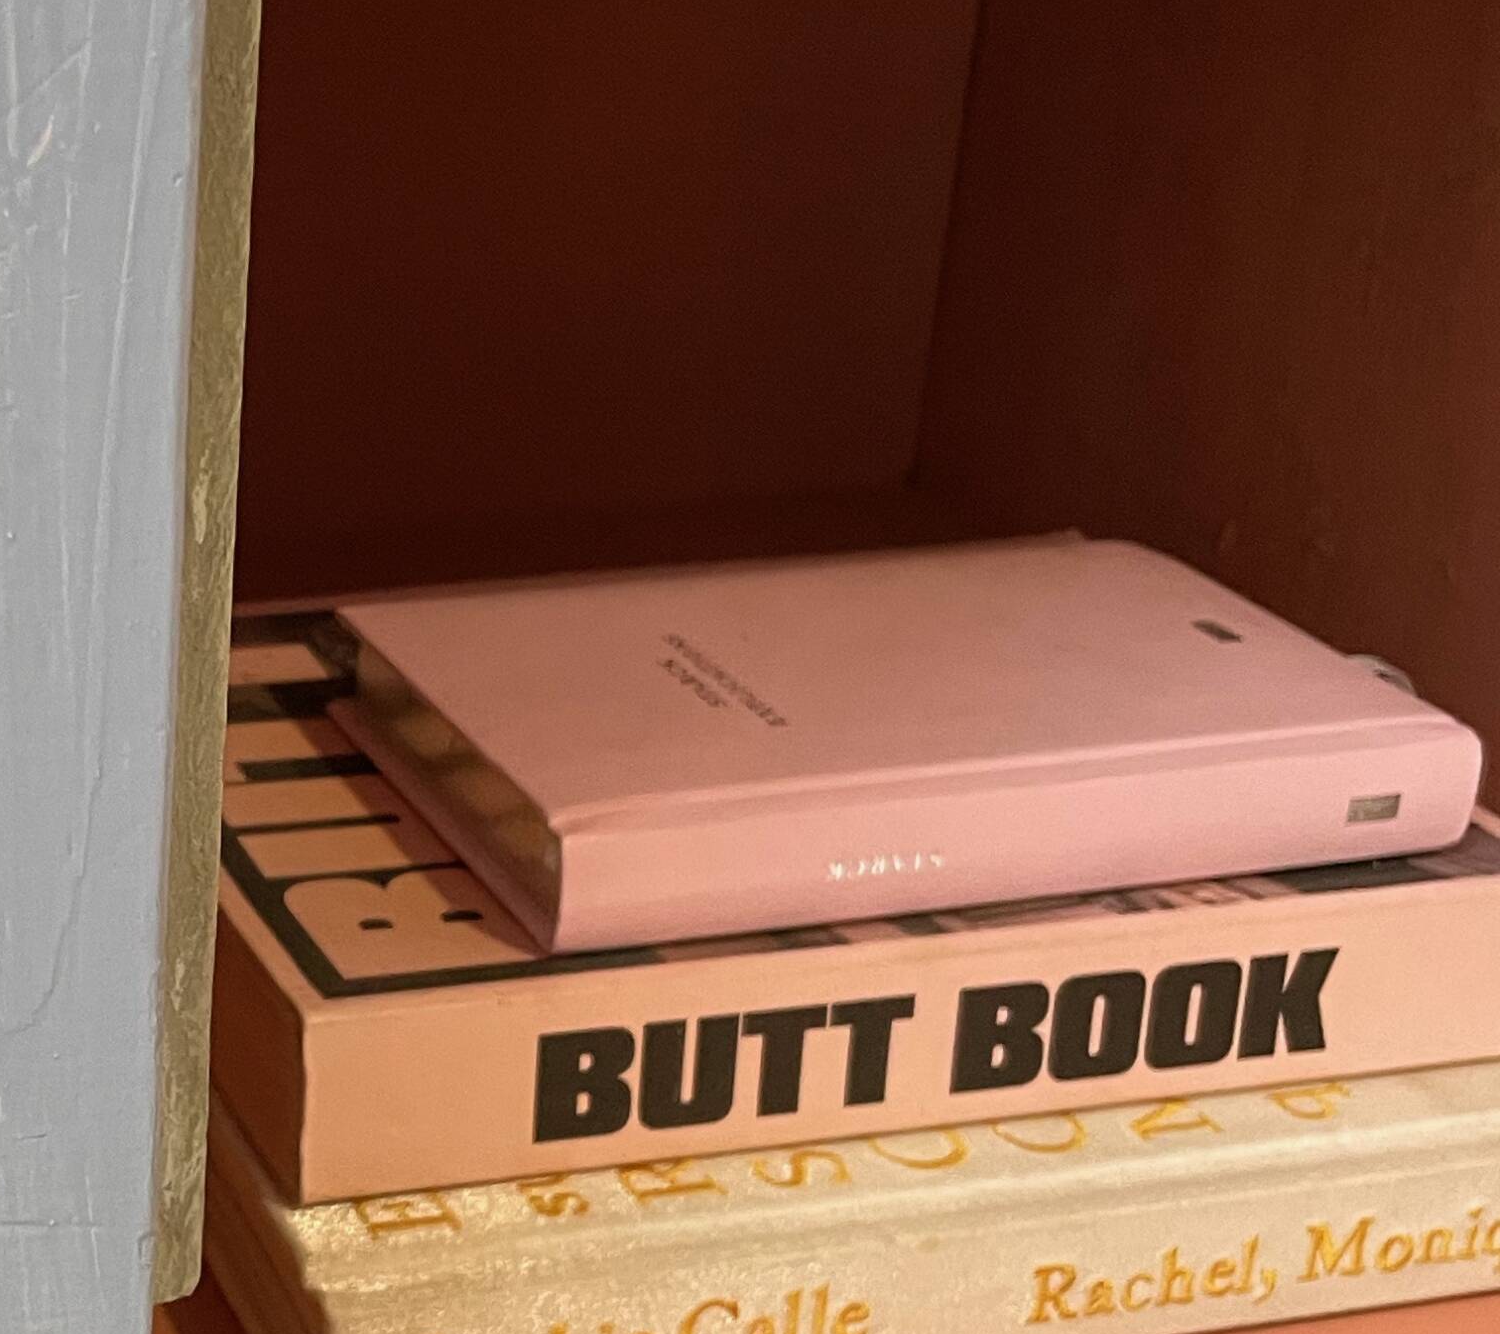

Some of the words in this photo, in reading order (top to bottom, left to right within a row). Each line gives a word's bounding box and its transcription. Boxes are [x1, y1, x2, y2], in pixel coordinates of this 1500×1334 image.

[533, 994, 916, 1144] BUTT
[949, 946, 1340, 1095] BOOK
[1024, 1232, 1278, 1325] Rachel,
